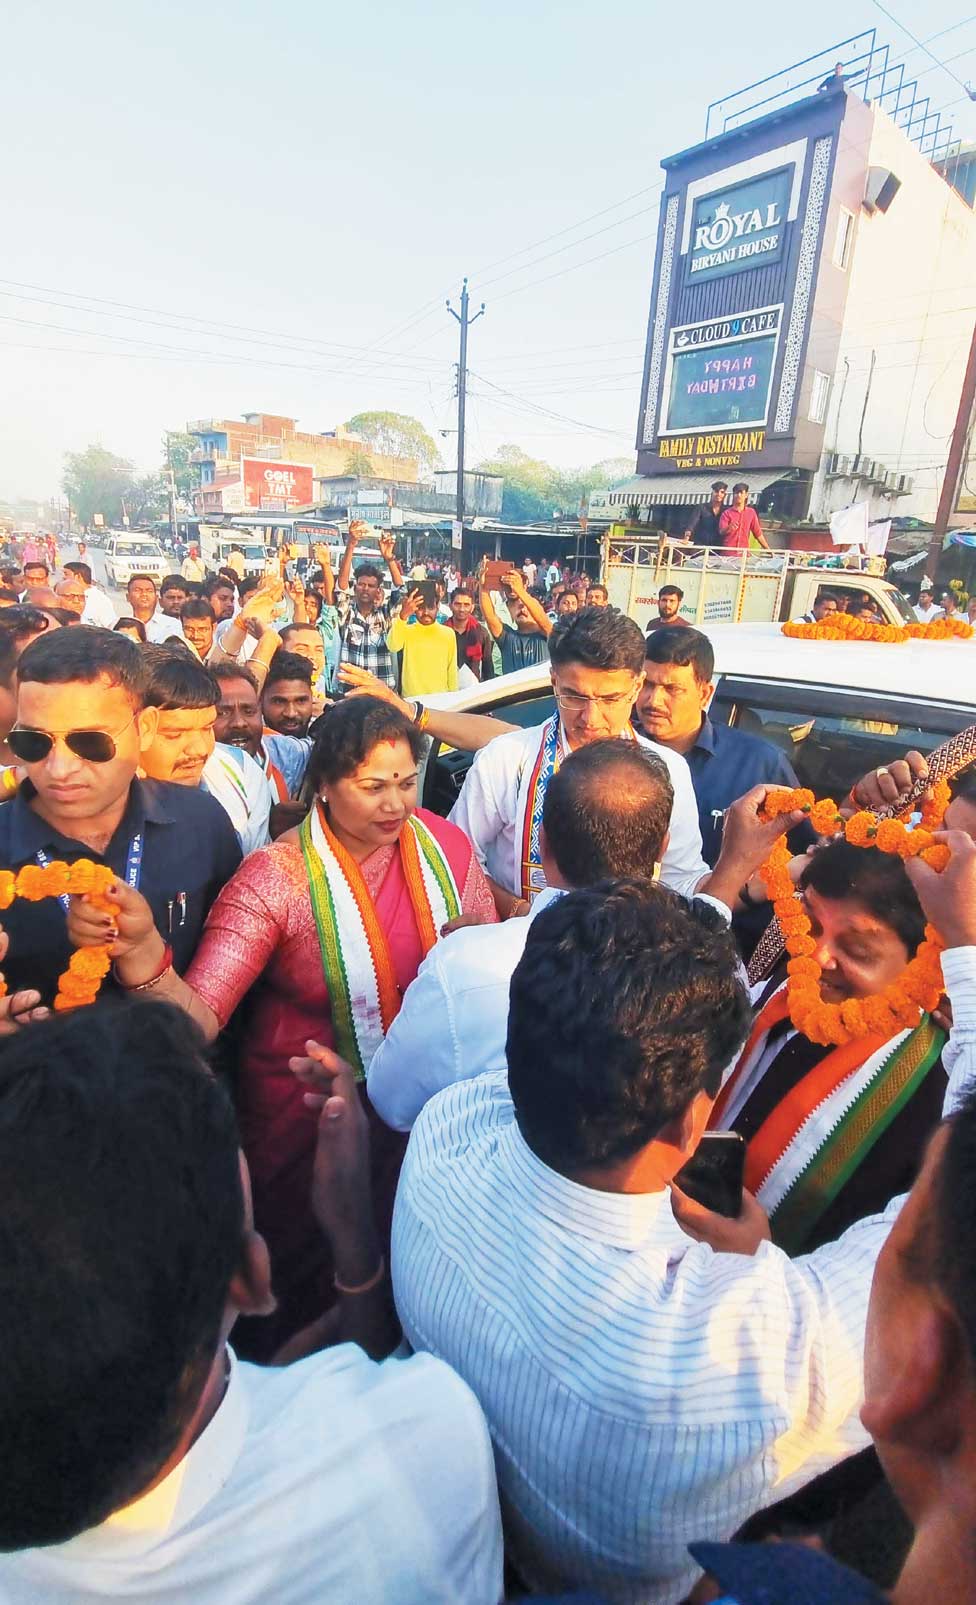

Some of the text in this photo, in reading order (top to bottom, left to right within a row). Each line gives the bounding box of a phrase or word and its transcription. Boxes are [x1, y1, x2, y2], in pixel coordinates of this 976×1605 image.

[693, 203, 780, 250] ROYAL
[691, 234, 779, 272] BIRYANI HOUSE
[690, 313, 775, 343] CLOUD 9 CAFE
[659, 431, 765, 458] FAMILY RESTAURANT
[676, 455, 740, 468] VEG & NONVEG
[264, 469, 296, 483] GOEL
[268, 483, 293, 496] TMT
[129, 868, 137, 887] OLICE
